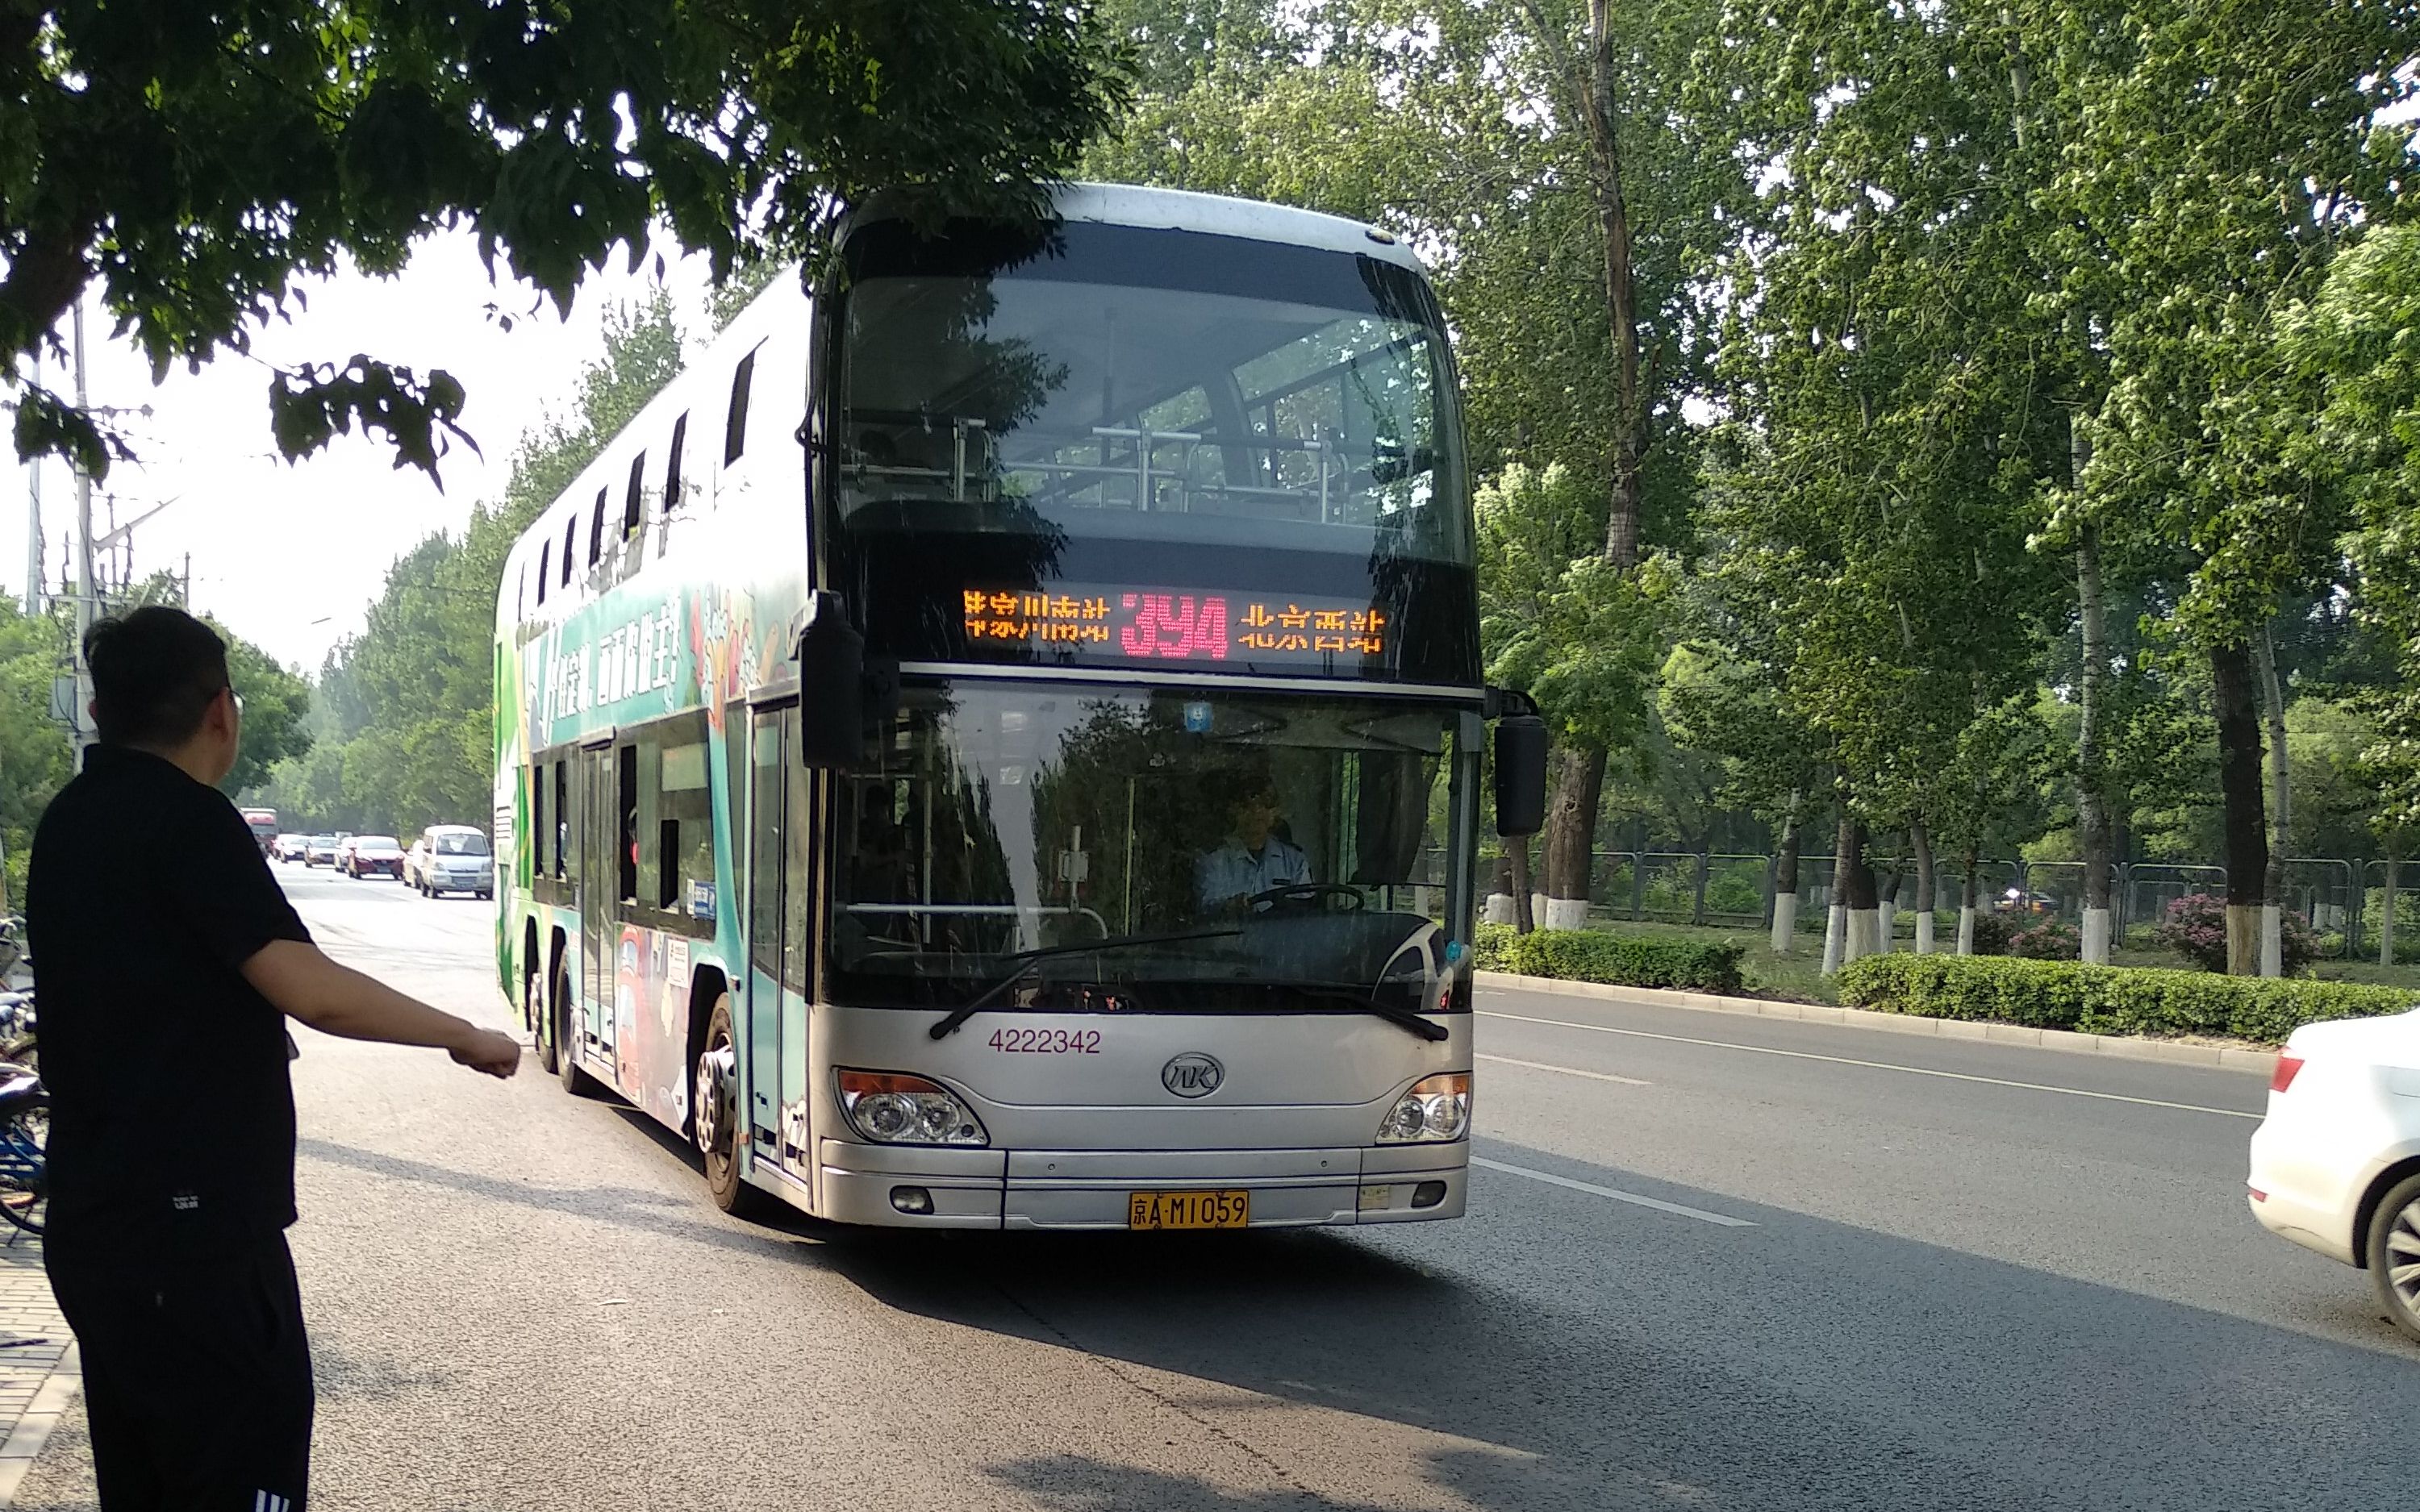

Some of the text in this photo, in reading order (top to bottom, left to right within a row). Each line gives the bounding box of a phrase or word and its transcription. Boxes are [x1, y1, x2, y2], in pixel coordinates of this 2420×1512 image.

[1121, 594, 1228, 658] 394
[1237, 603, 1386, 655] 北京西站
[988, 1028, 1101, 1054] 4222342
